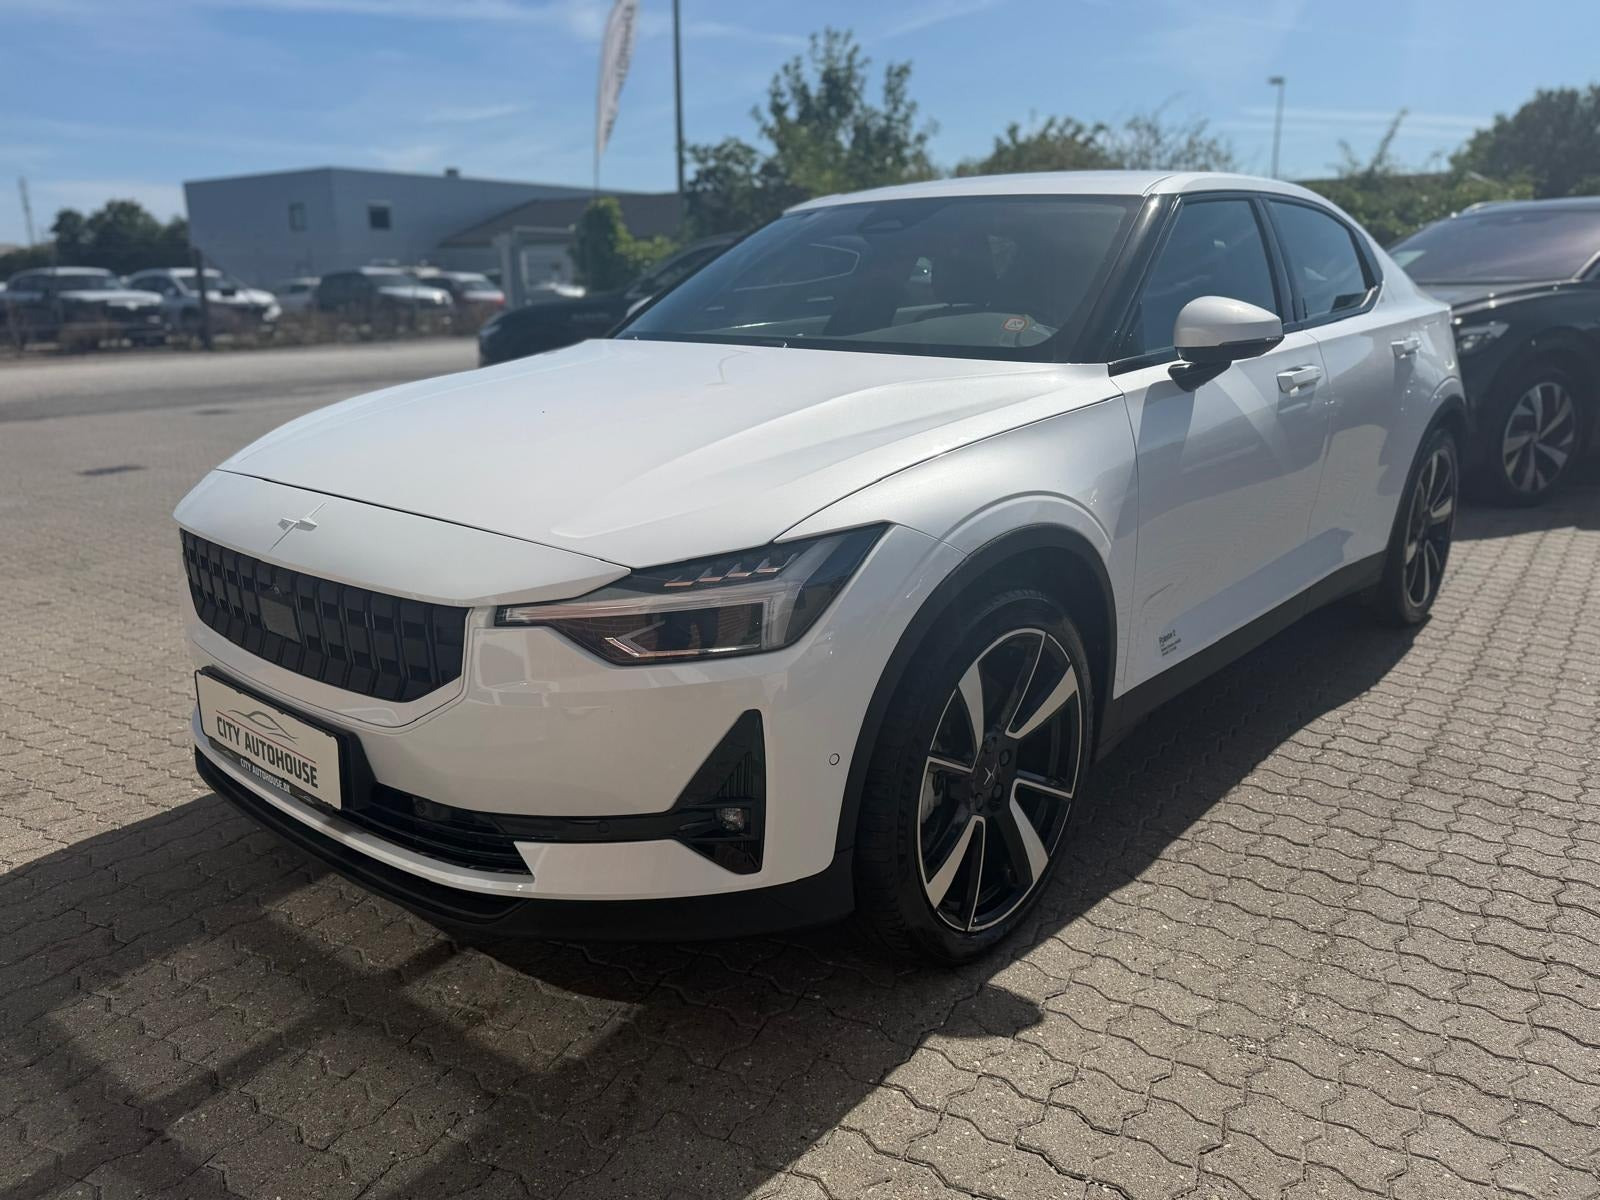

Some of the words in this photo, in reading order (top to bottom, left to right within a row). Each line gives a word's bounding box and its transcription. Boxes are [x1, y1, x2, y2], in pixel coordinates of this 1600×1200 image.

[216, 715, 240, 746] CITY
[244, 732, 319, 789] AUTOHOUSE
[240, 758, 251, 772] CITY
